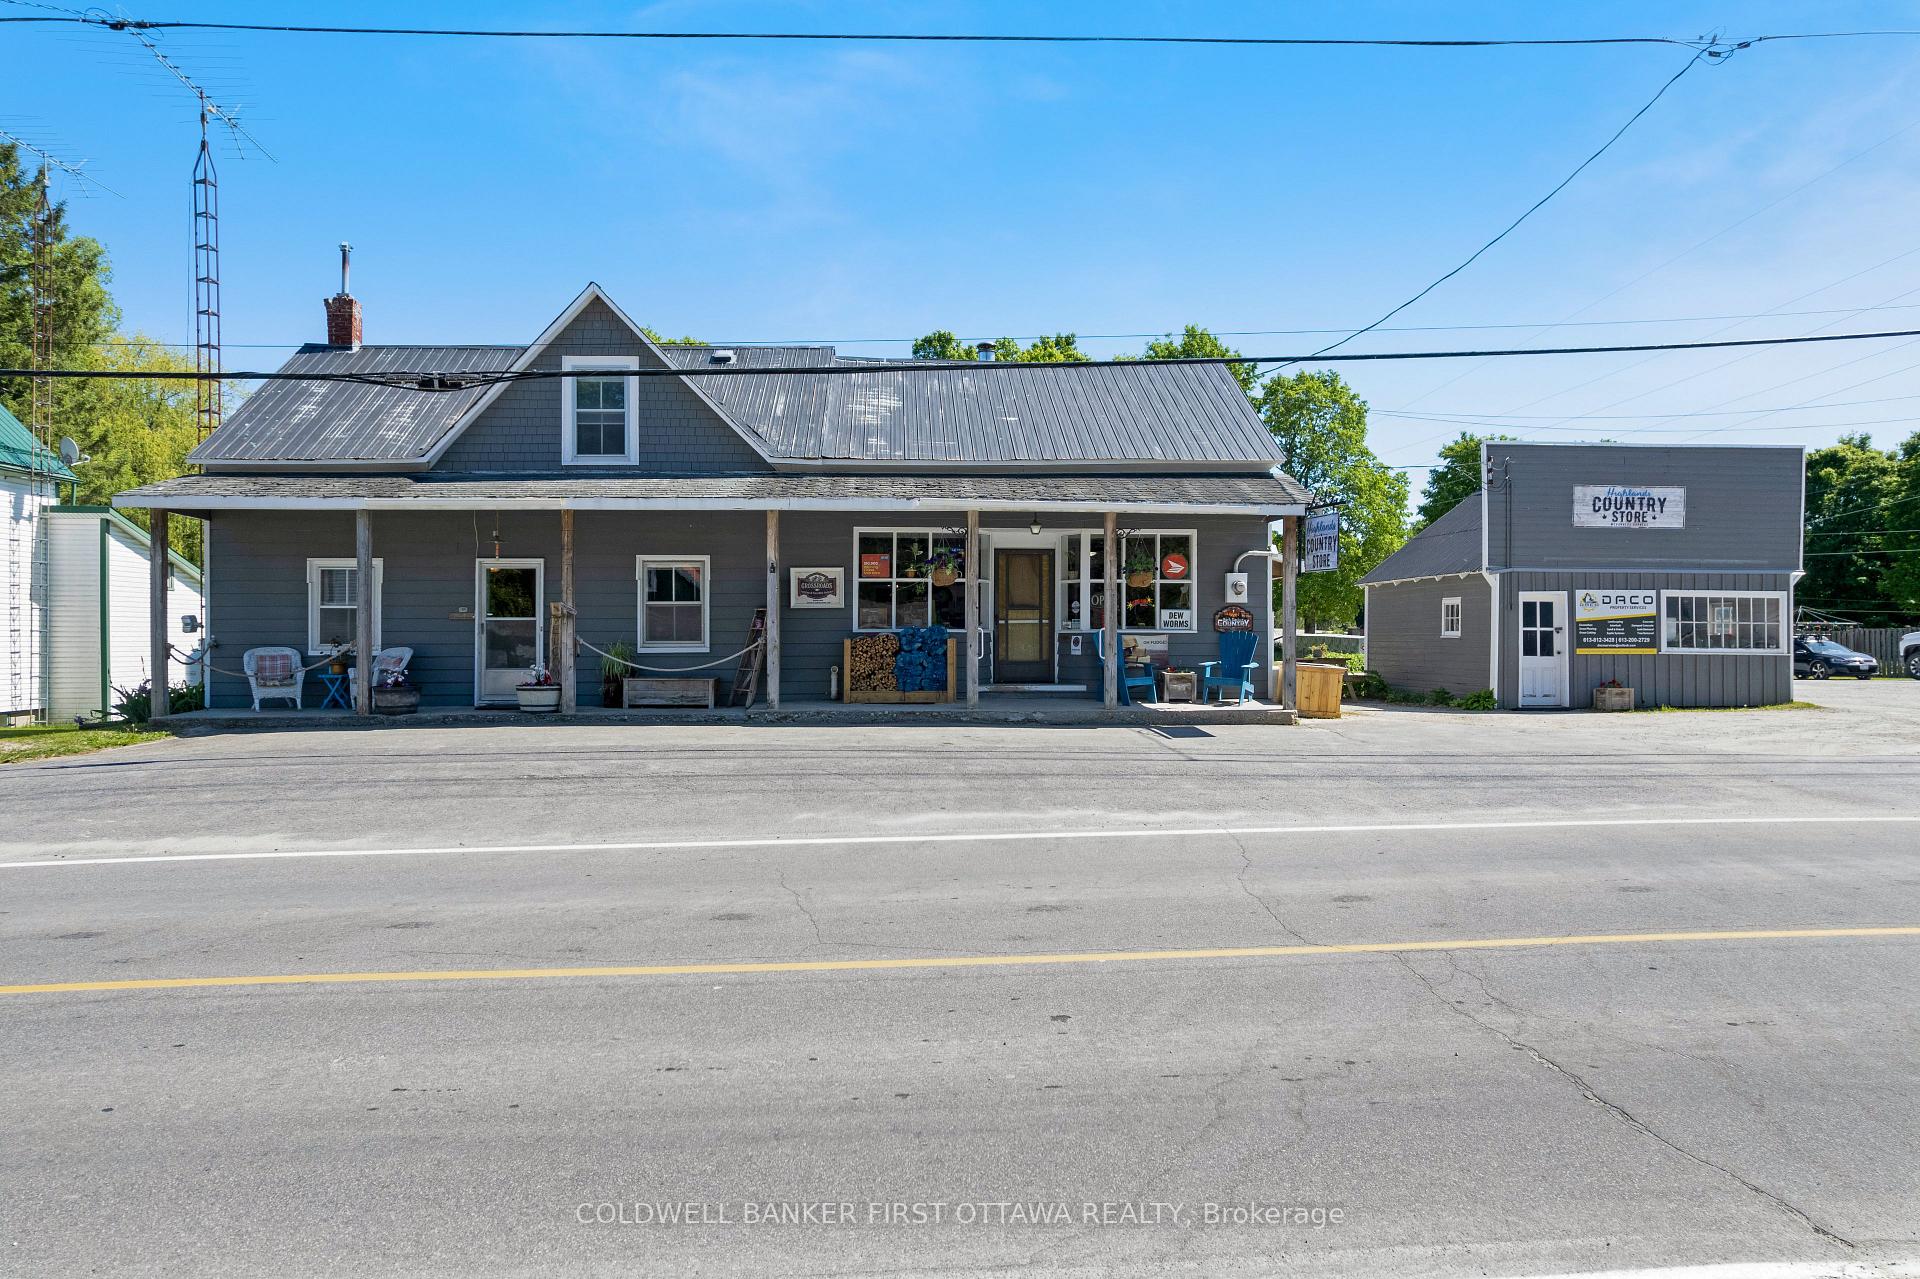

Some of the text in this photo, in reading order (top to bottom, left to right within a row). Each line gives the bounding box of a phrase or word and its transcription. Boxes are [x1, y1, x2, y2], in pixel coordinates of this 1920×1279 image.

[1607, 487, 1651, 497] Highlands
[1592, 496, 1667, 514] COUNTRY
[1612, 511, 1648, 523] STORE
[1307, 535, 1337, 554] COUNTRY
[1312, 554, 1330, 568] STORE
[1602, 595, 1654, 605] DACO
[1168, 611, 1185, 620] DEW
[1163, 620, 1189, 628] WORMS
